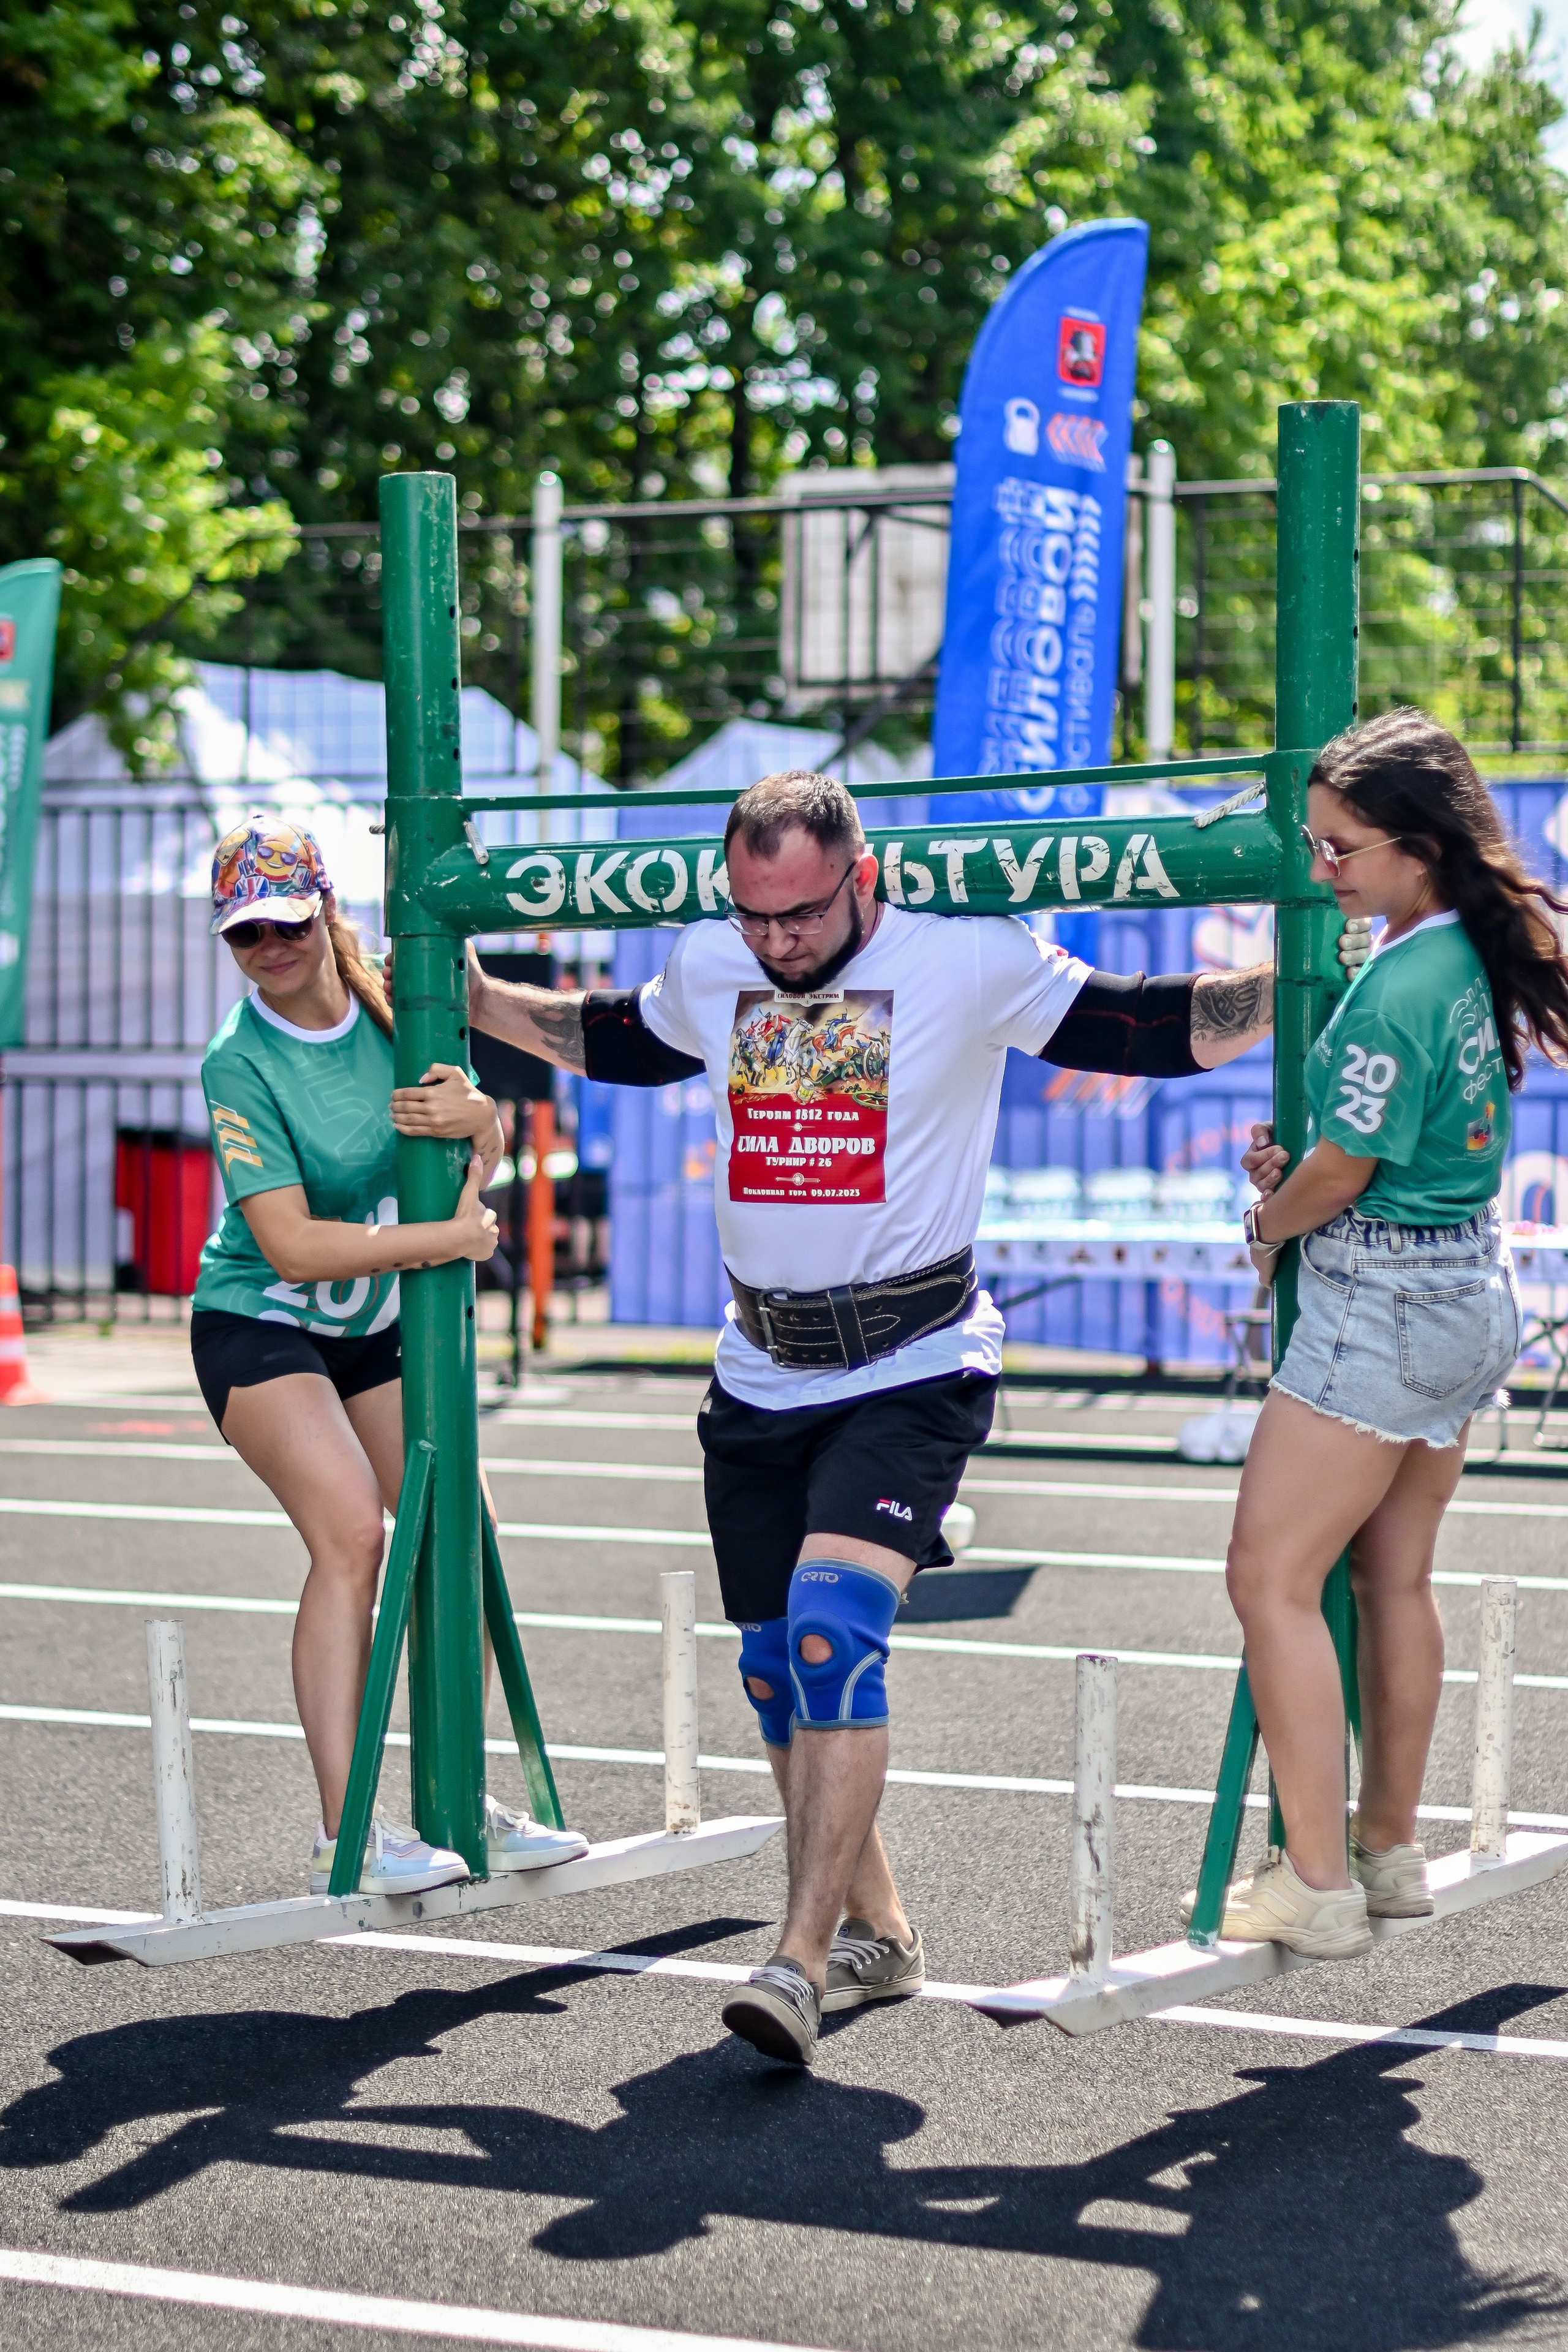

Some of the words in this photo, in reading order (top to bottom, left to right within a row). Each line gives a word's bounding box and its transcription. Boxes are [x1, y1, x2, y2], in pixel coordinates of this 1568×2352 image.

[1058, 603, 1096, 815] фстиваль
[506, 834, 1180, 916] ЭКОКЬТУРА
[1341, 1044, 1399, 1093] 20
[795, 1109, 823, 1120] 1812
[1335, 1084, 1389, 1134] 23
[737, 1136, 779, 1153] СИЛА
[788, 1136, 876, 1155] ДВОРОВ
[766, 1156, 806, 1166] ТУРНИР
[809, 1157, 815, 1166] #
[818, 1158, 832, 1167] 26
[810, 1188, 861, 1197] 09.07.2023
[876, 1498, 913, 1521] FILA
